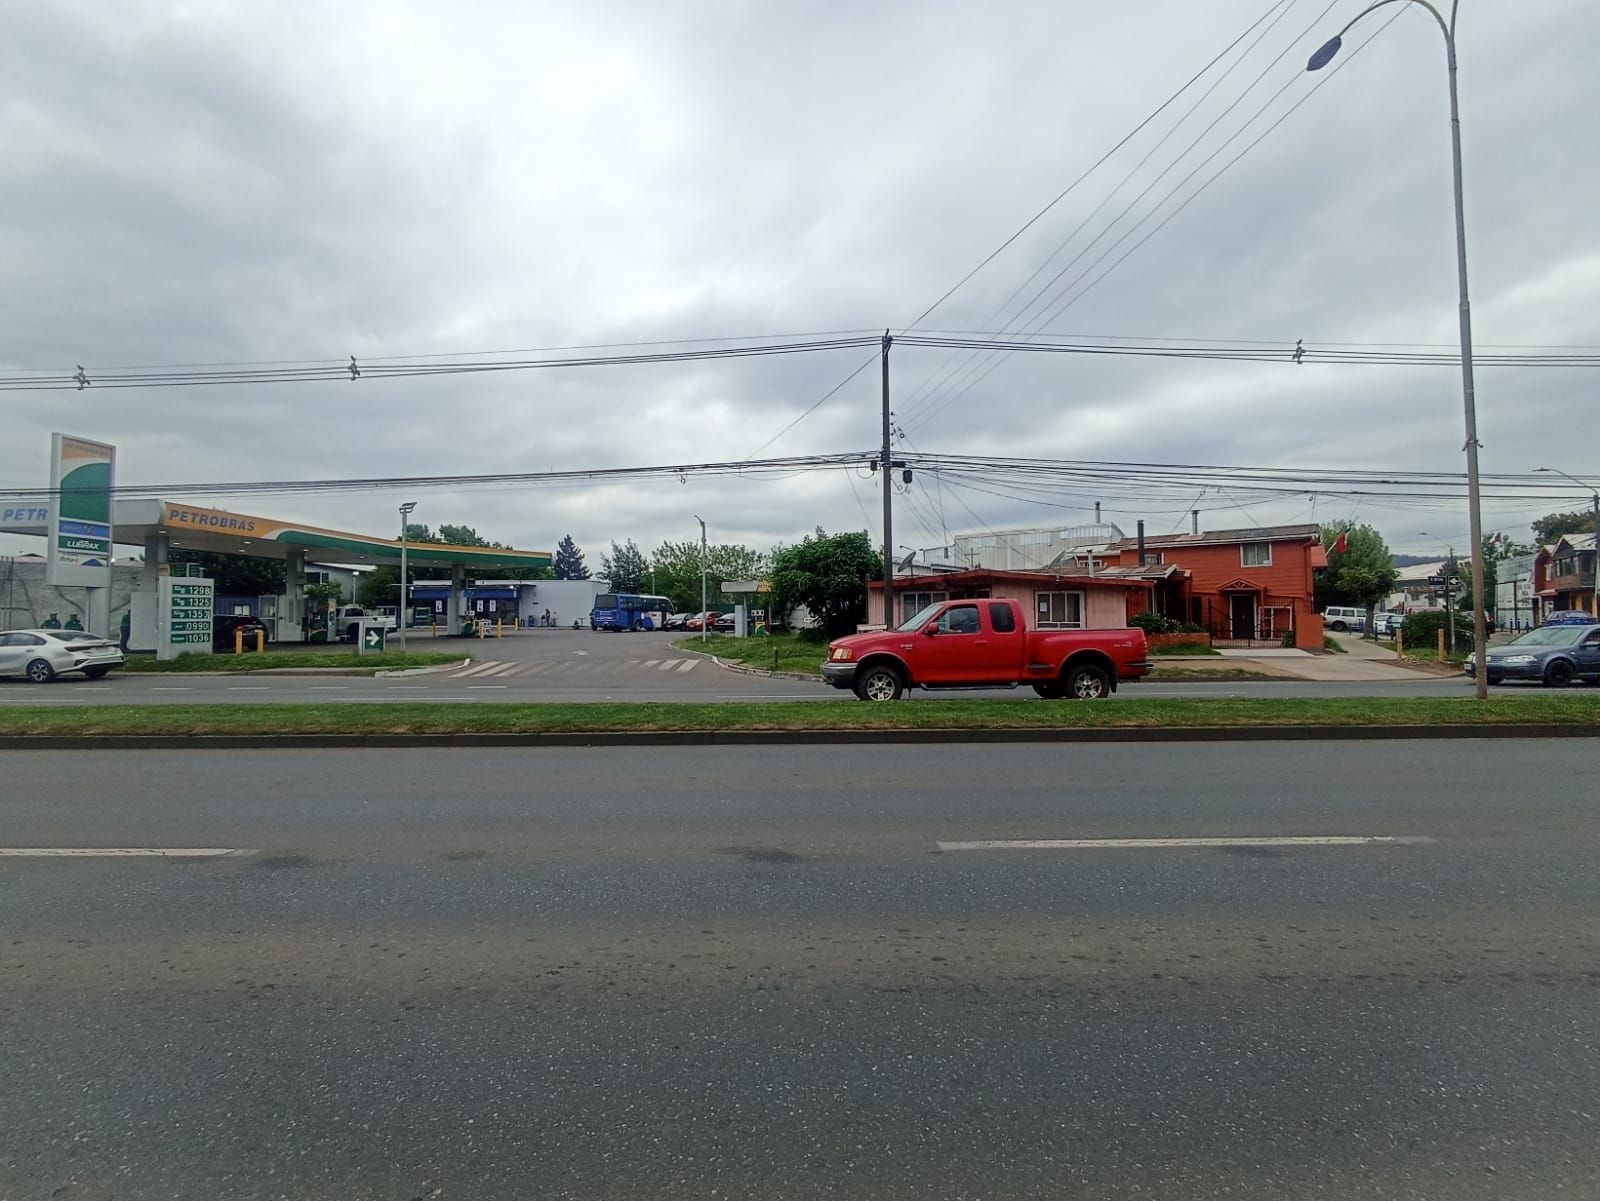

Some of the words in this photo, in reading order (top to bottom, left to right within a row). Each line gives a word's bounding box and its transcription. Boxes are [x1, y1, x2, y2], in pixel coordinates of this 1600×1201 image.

[169, 509, 256, 532] PETROBRAS
[67, 539, 99, 550] LUBRAX
[189, 586, 210, 595] 1298
[189, 598, 210, 606] 1325
[188, 634, 209, 642] 1036
